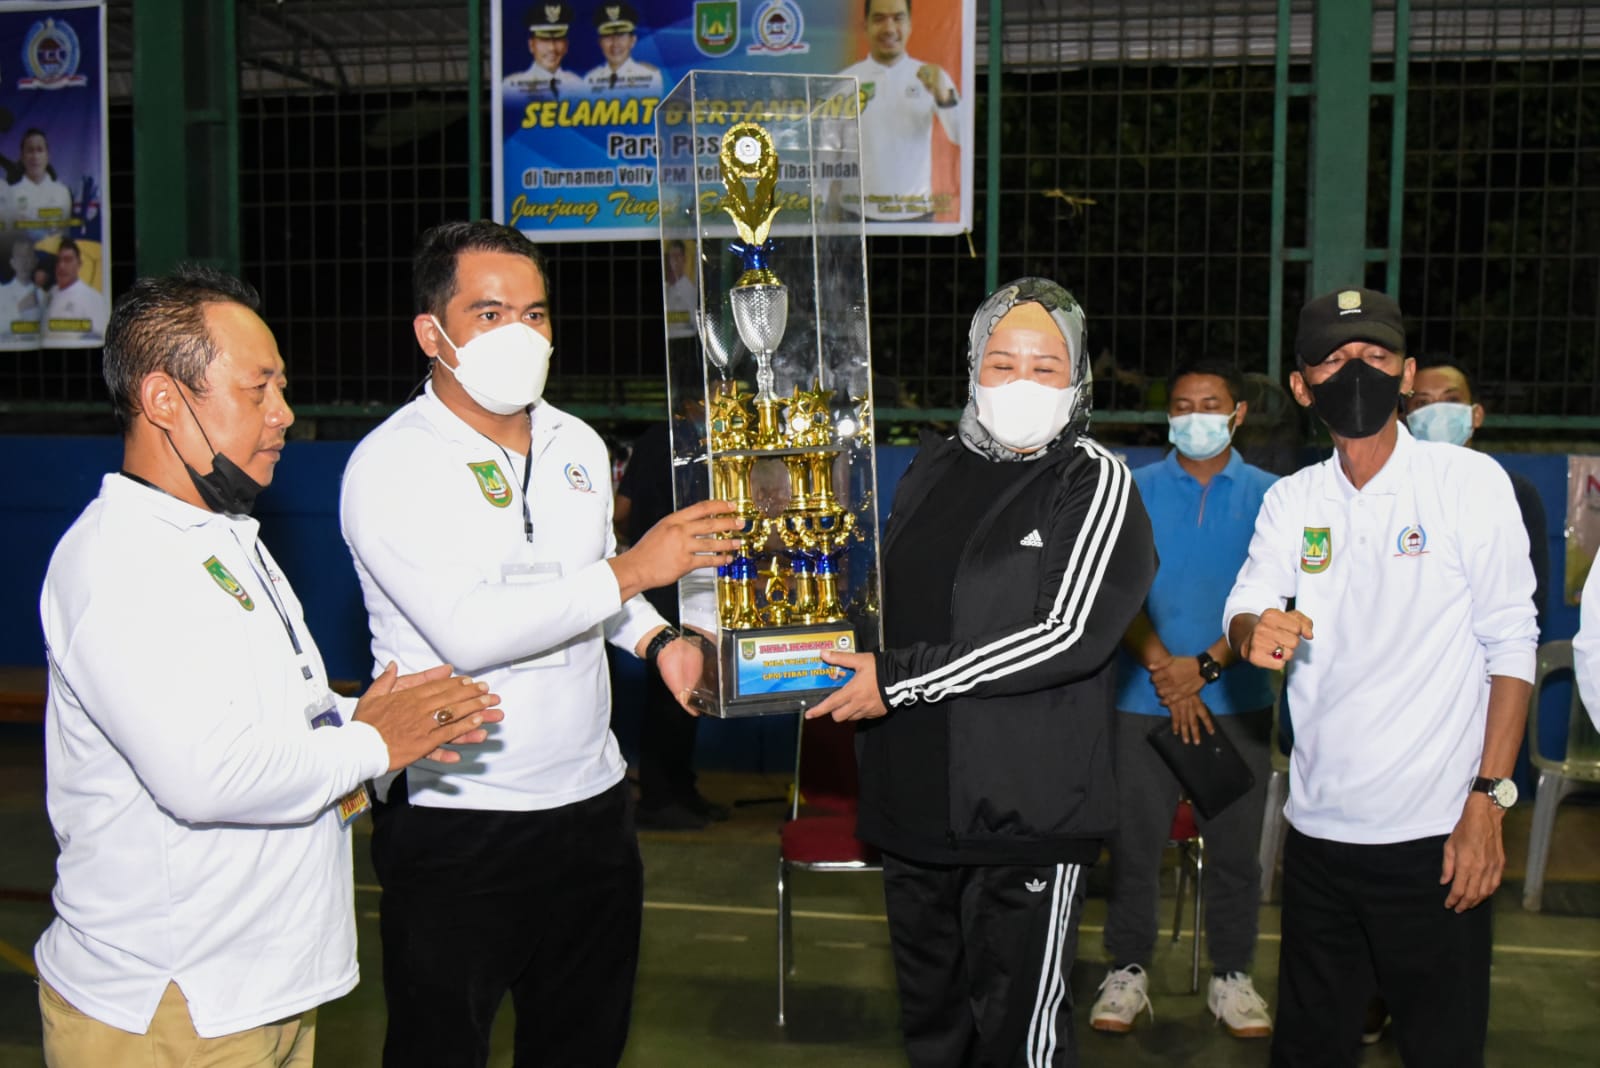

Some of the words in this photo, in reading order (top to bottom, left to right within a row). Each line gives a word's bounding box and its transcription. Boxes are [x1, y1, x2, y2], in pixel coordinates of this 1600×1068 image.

[522, 98, 660, 128] SELAMAT
[665, 92, 867, 125] BERTANDING
[609, 133, 664, 157] Para
[524, 169, 537, 186] di
[543, 168, 614, 186] Turnamen
[619, 167, 655, 185] Volly
[821, 161, 859, 179] Indah
[509, 194, 600, 227] Junjung
